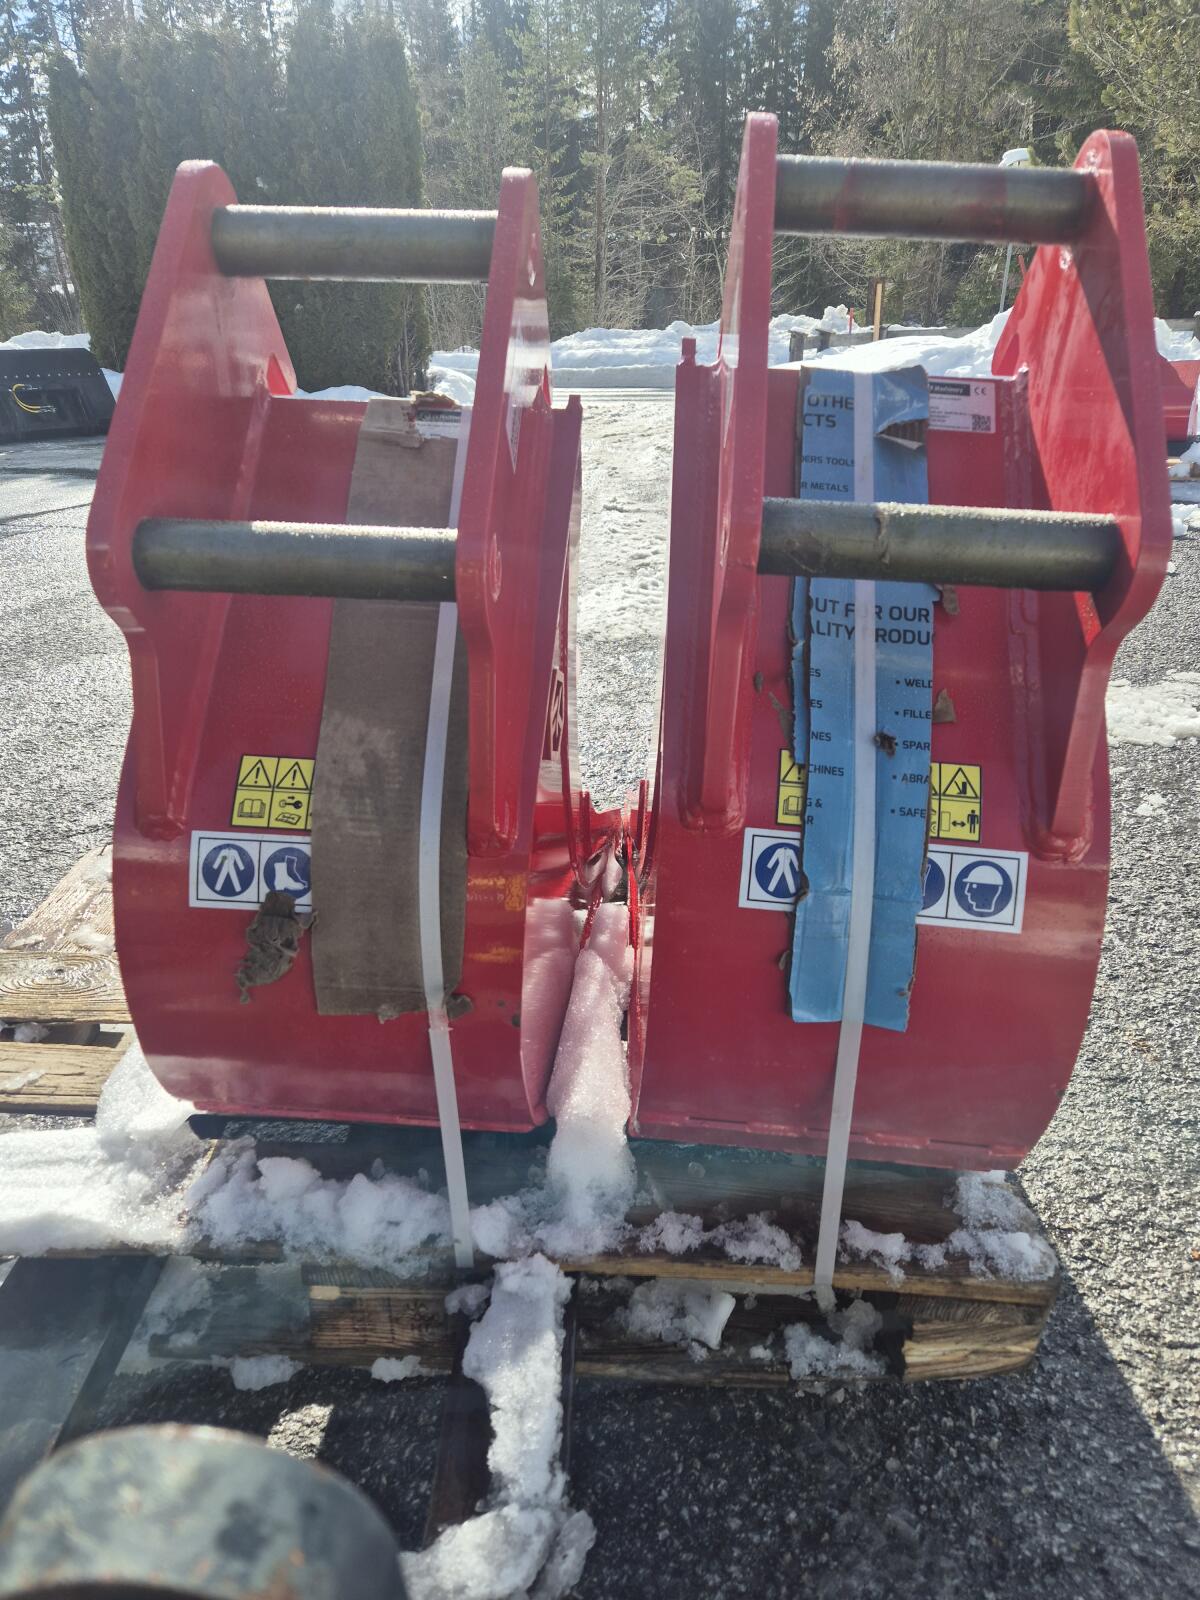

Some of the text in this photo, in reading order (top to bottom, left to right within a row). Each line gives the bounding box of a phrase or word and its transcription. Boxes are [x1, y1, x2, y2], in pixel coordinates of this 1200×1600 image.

[810, 481, 849, 493] METALS
[844, 603, 883, 620] FR
[888, 606, 930, 623] OUR
[811, 619, 933, 646] LITY RODU
[903, 709, 932, 720] FILLE
[902, 740, 930, 751] SPAR
[899, 807, 927, 818] SAFE
